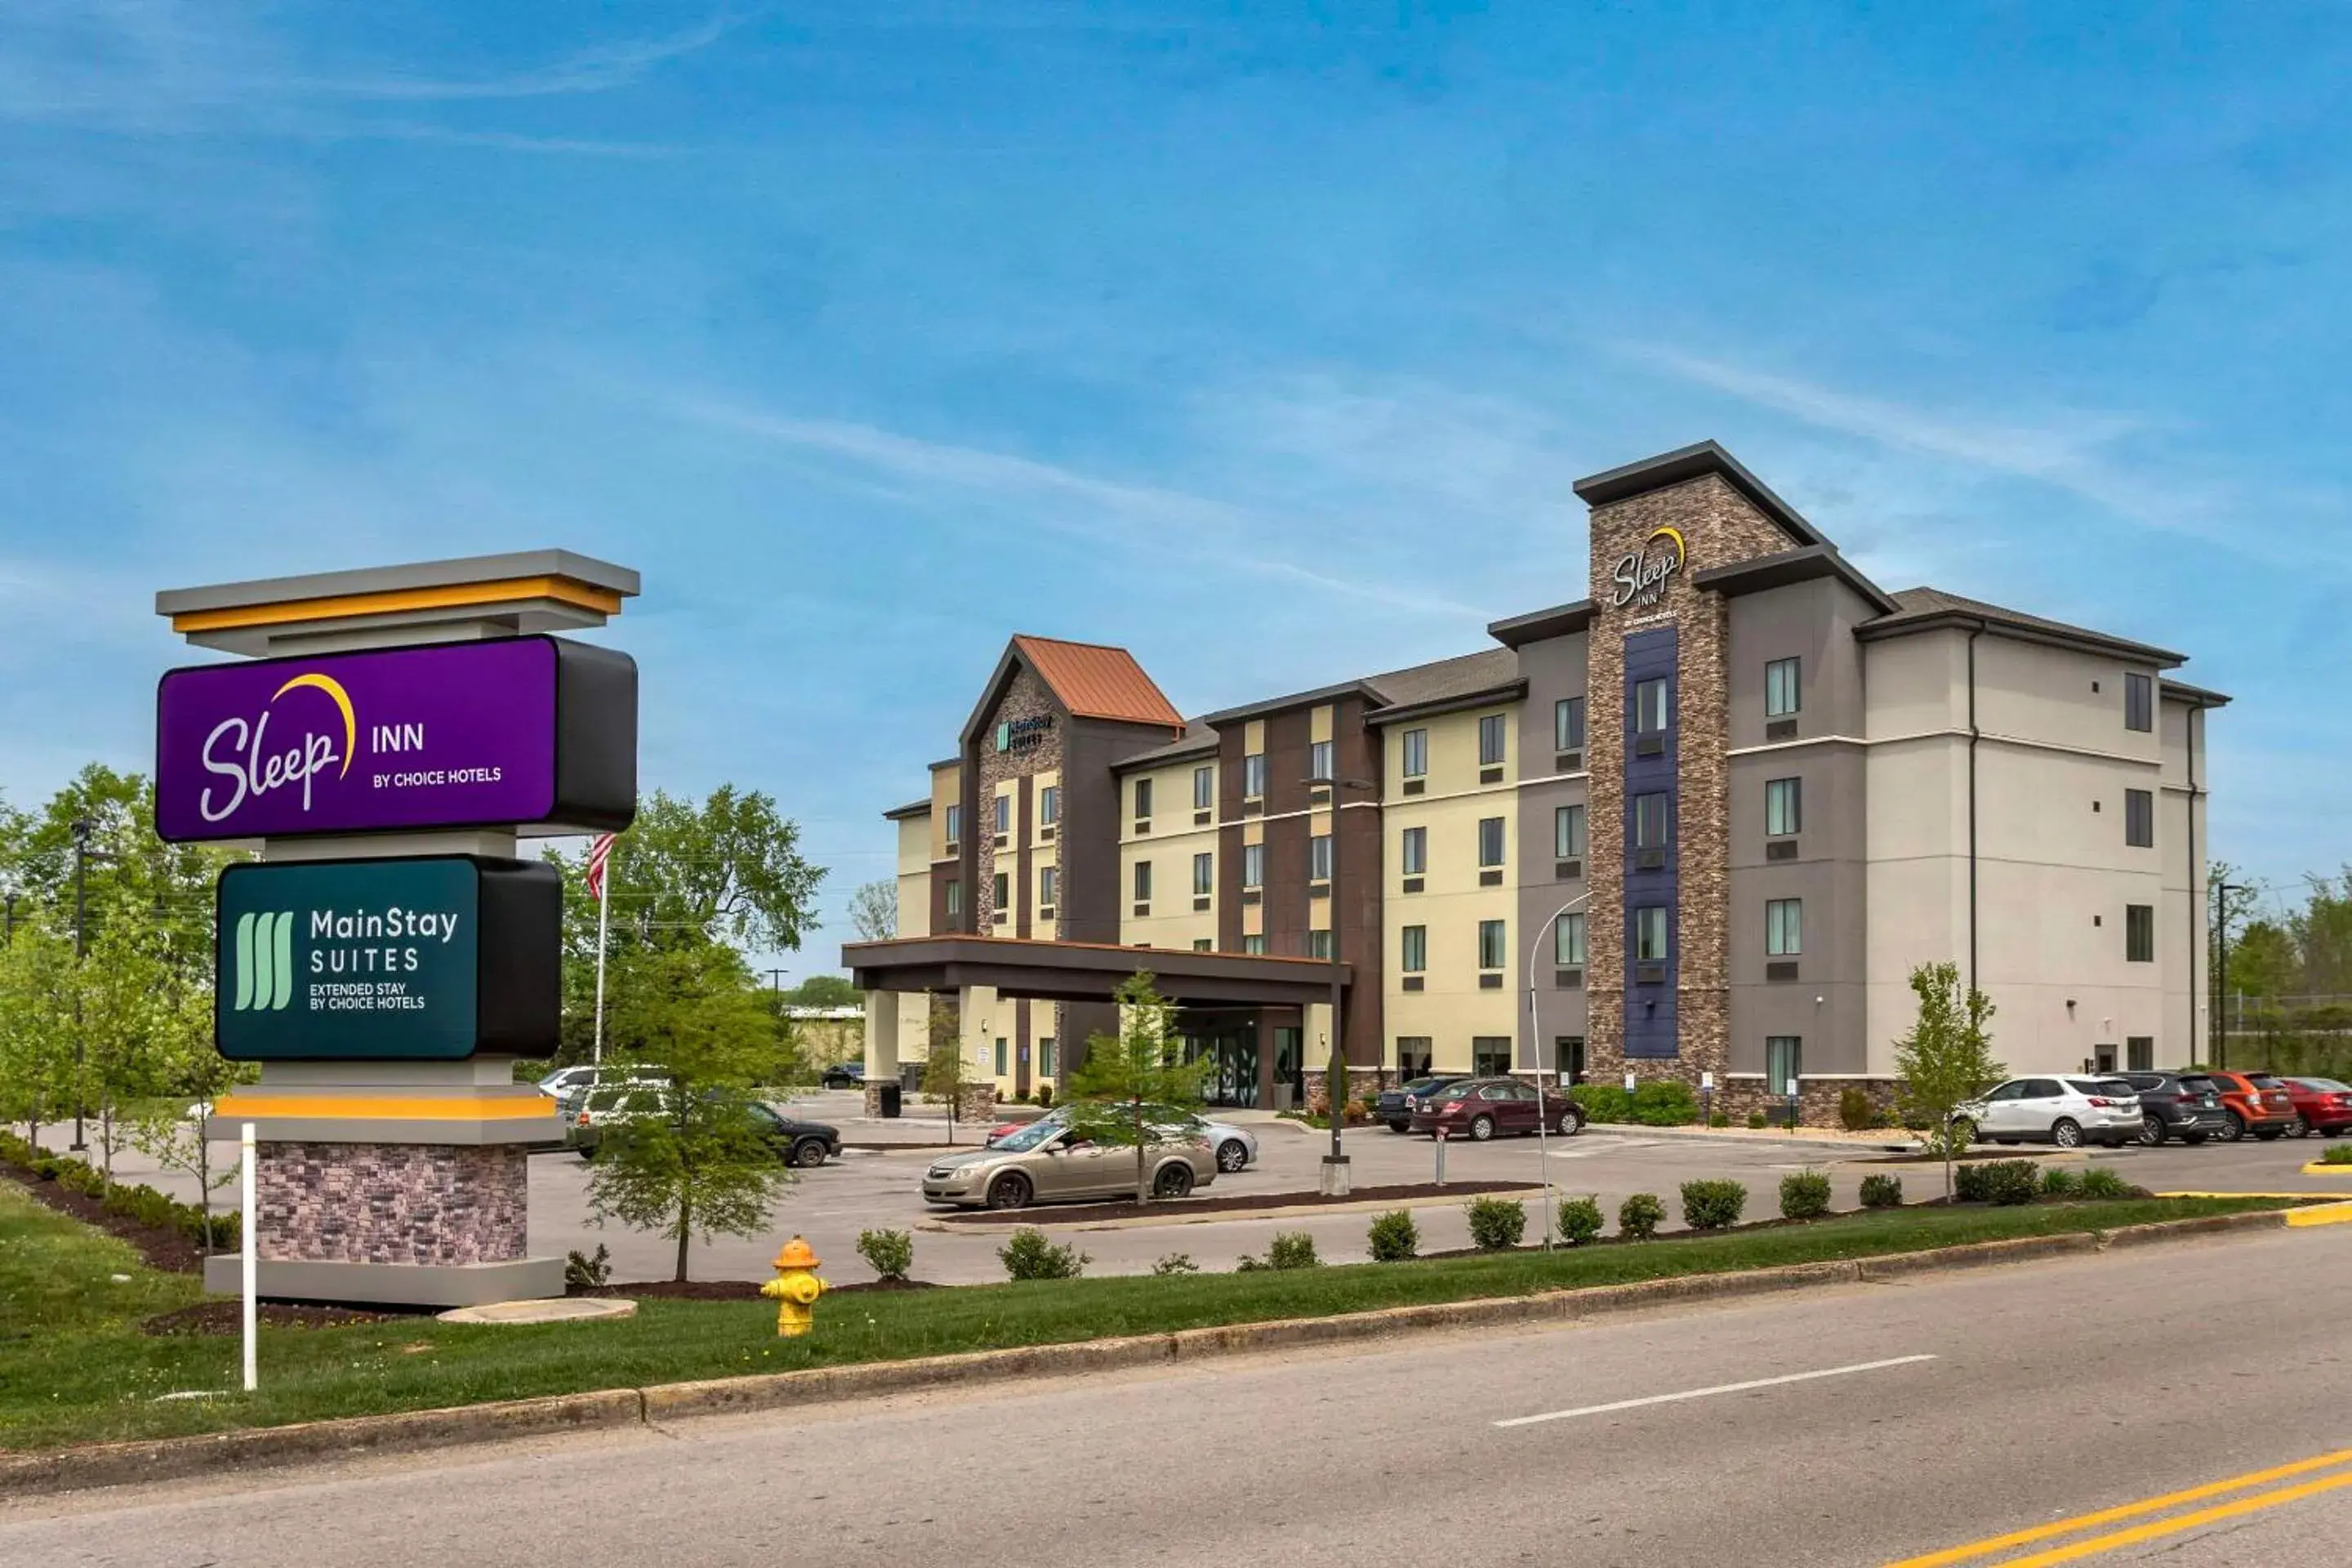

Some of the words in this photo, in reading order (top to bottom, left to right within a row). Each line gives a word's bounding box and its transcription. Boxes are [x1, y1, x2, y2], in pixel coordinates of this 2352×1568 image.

[1614, 550, 1679, 606] Sleep
[1638, 594, 1658, 606] INN
[200, 711, 340, 822] Sleep
[372, 723, 424, 753] INN
[373, 774, 391, 788] BY
[394, 770, 445, 786] CHOICE
[448, 767, 501, 783] HOTELS
[310, 907, 458, 943] MainStay
[310, 947, 419, 973] SUITES
[310, 982, 374, 996] EXTENDED
[376, 982, 407, 996] STAY
[310, 998, 326, 1010] BY
[328, 996, 374, 1009] CHOICE
[377, 996, 425, 1009] HOTELS
